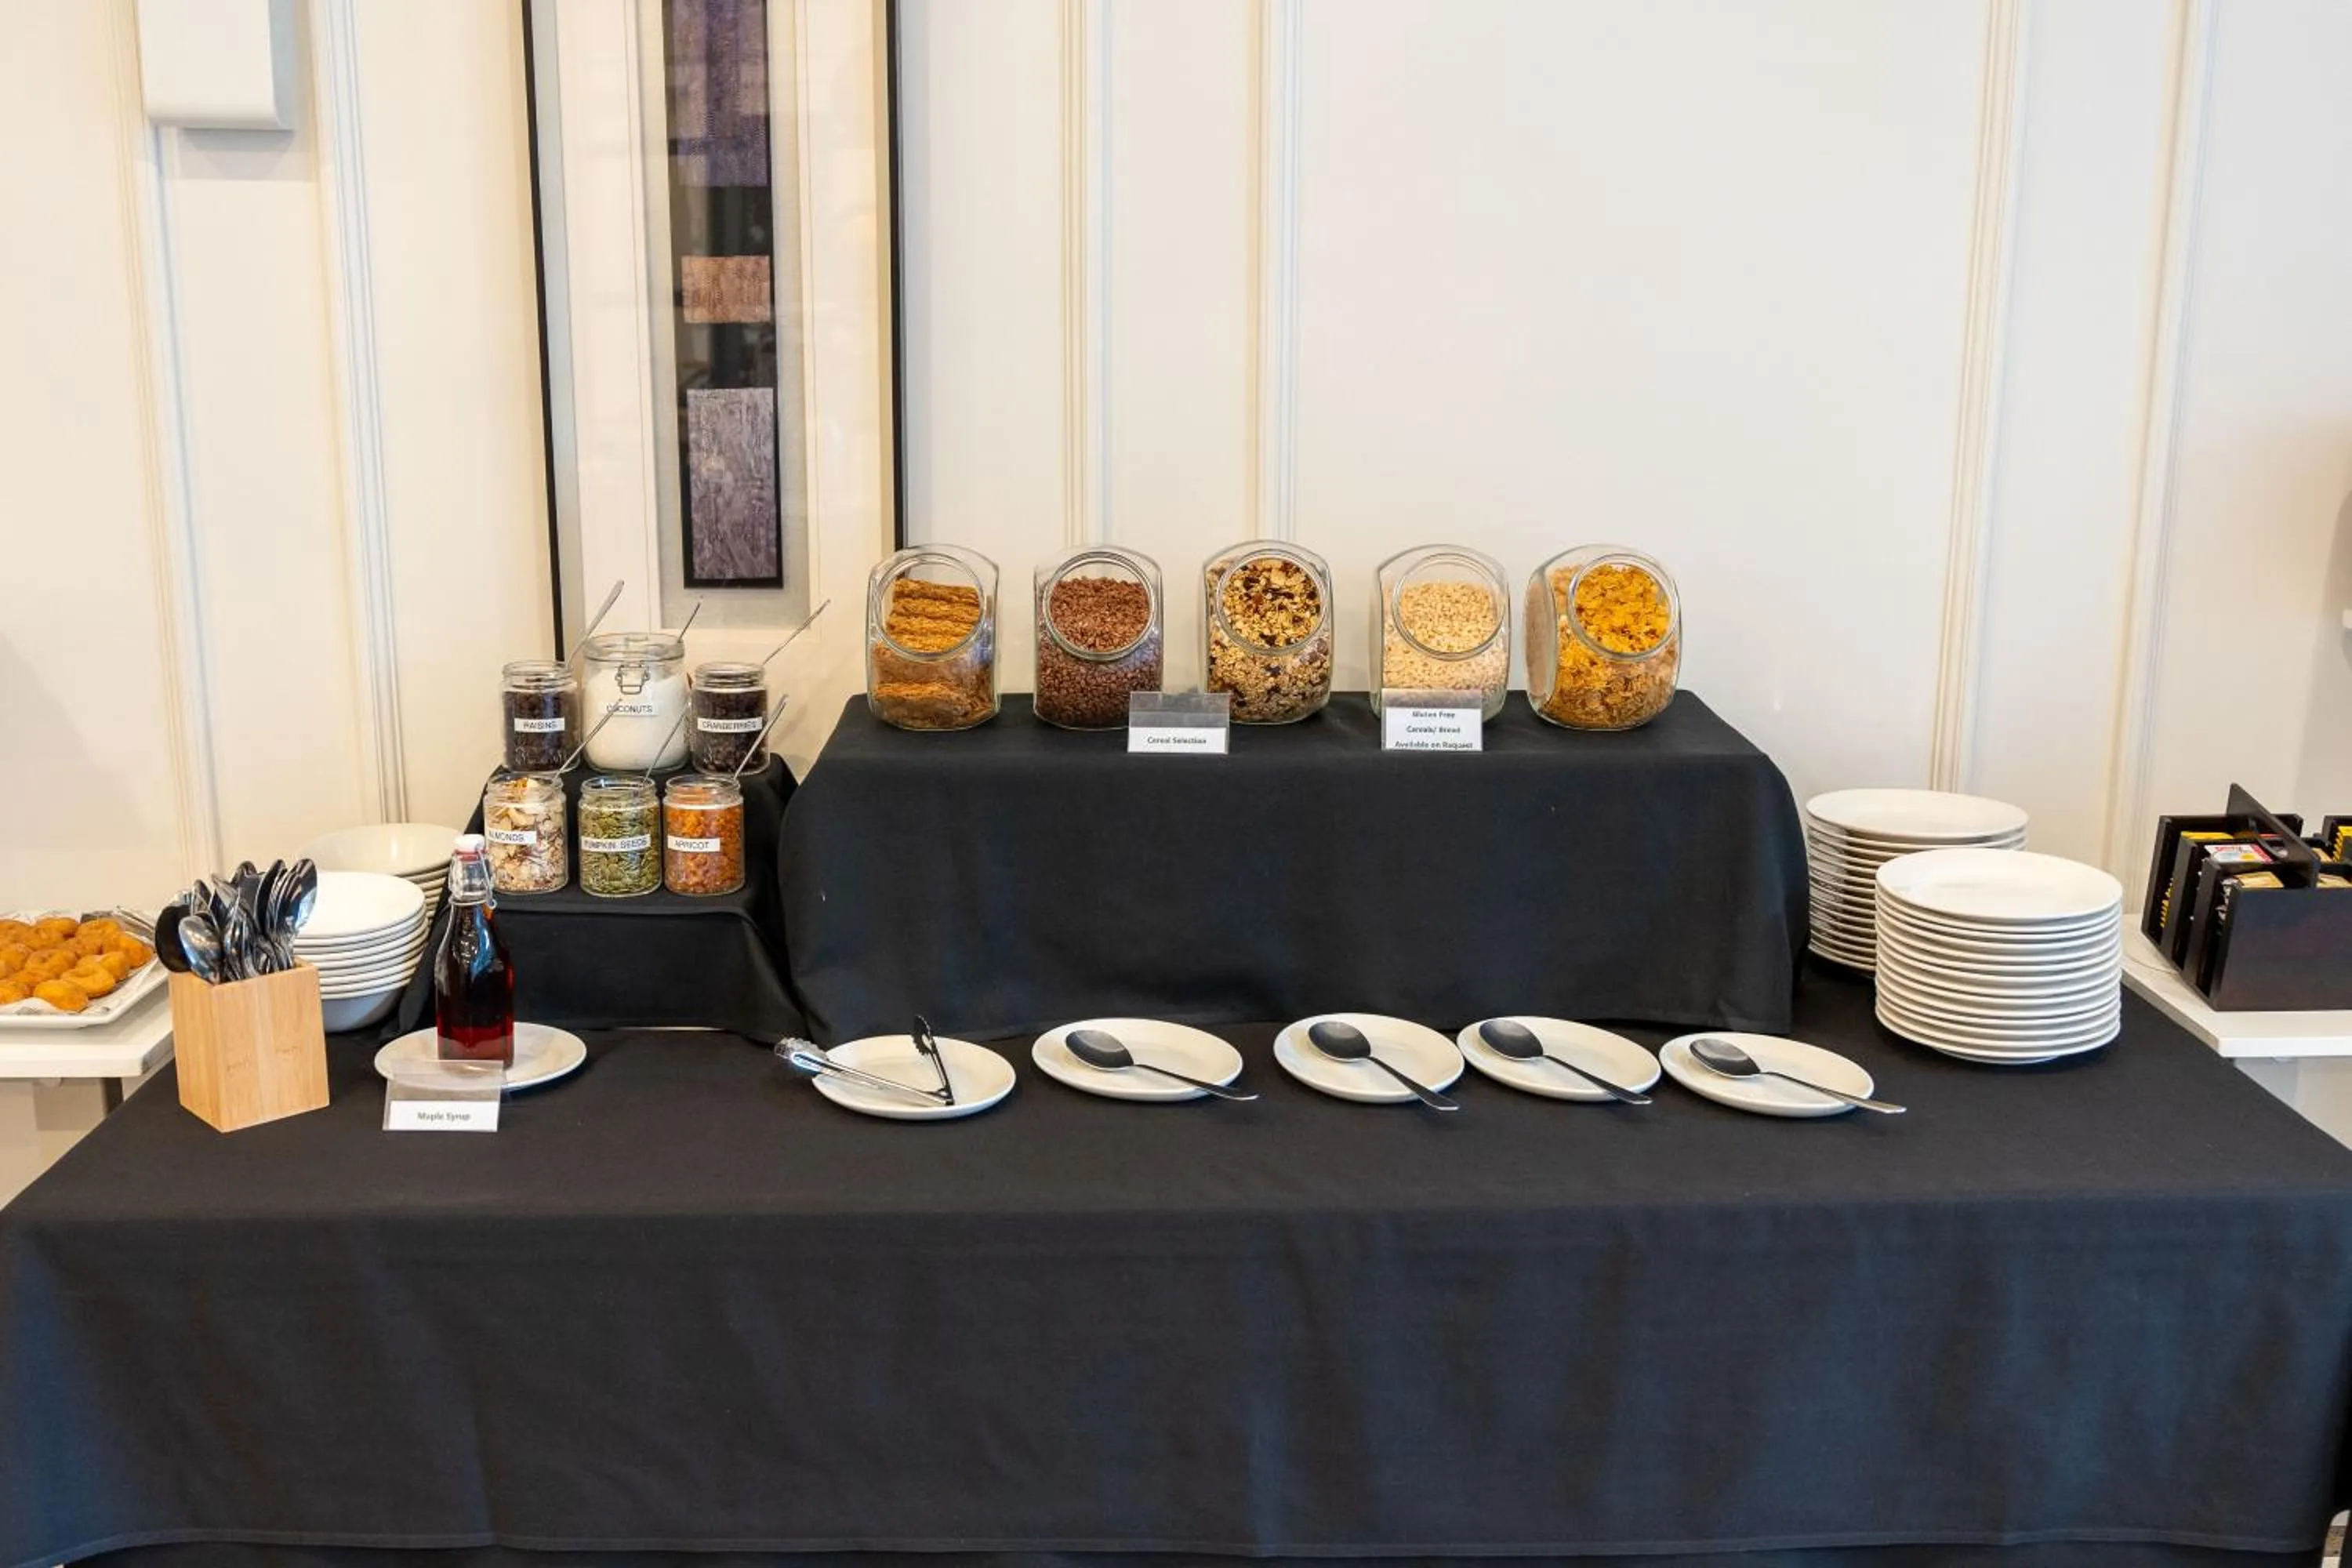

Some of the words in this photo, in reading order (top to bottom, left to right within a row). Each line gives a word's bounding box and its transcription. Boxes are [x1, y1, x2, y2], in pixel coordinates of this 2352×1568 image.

[523, 721, 557, 730] RAISINS
[702, 720, 757, 730] CRANBERRIES
[1442, 741, 1473, 750] Request
[674, 840, 710, 850] APRICOT
[417, 1112, 445, 1122] Maple
[446, 1112, 471, 1122] Syrup
